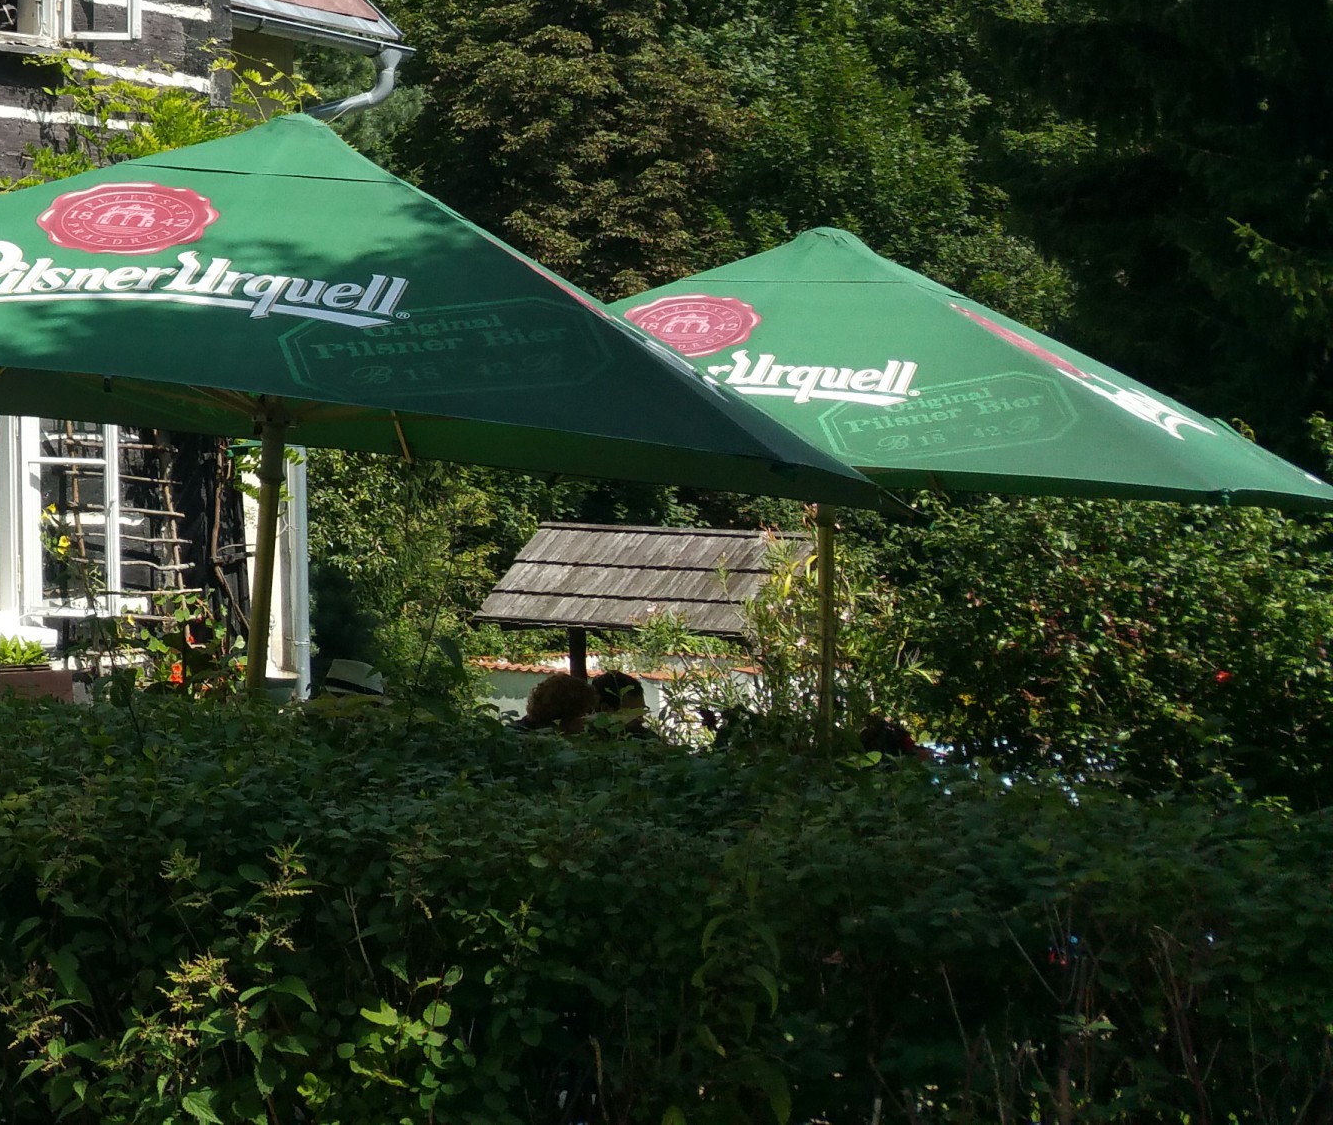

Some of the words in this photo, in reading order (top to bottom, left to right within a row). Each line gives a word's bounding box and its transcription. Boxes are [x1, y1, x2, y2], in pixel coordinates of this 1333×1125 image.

[67, 210, 94, 221] 18
[160, 218, 190, 228] 42
[162, 250, 410, 320] Urquell
[363, 314, 505, 337] Original
[714, 323, 738, 332] 42
[310, 336, 464, 359] Pilsner
[480, 328, 568, 347] Bier
[725, 349, 918, 404] Urquell
[884, 387, 993, 413] Original
[844, 408, 962, 434] Pilsner
[973, 395, 1044, 415] Bier
